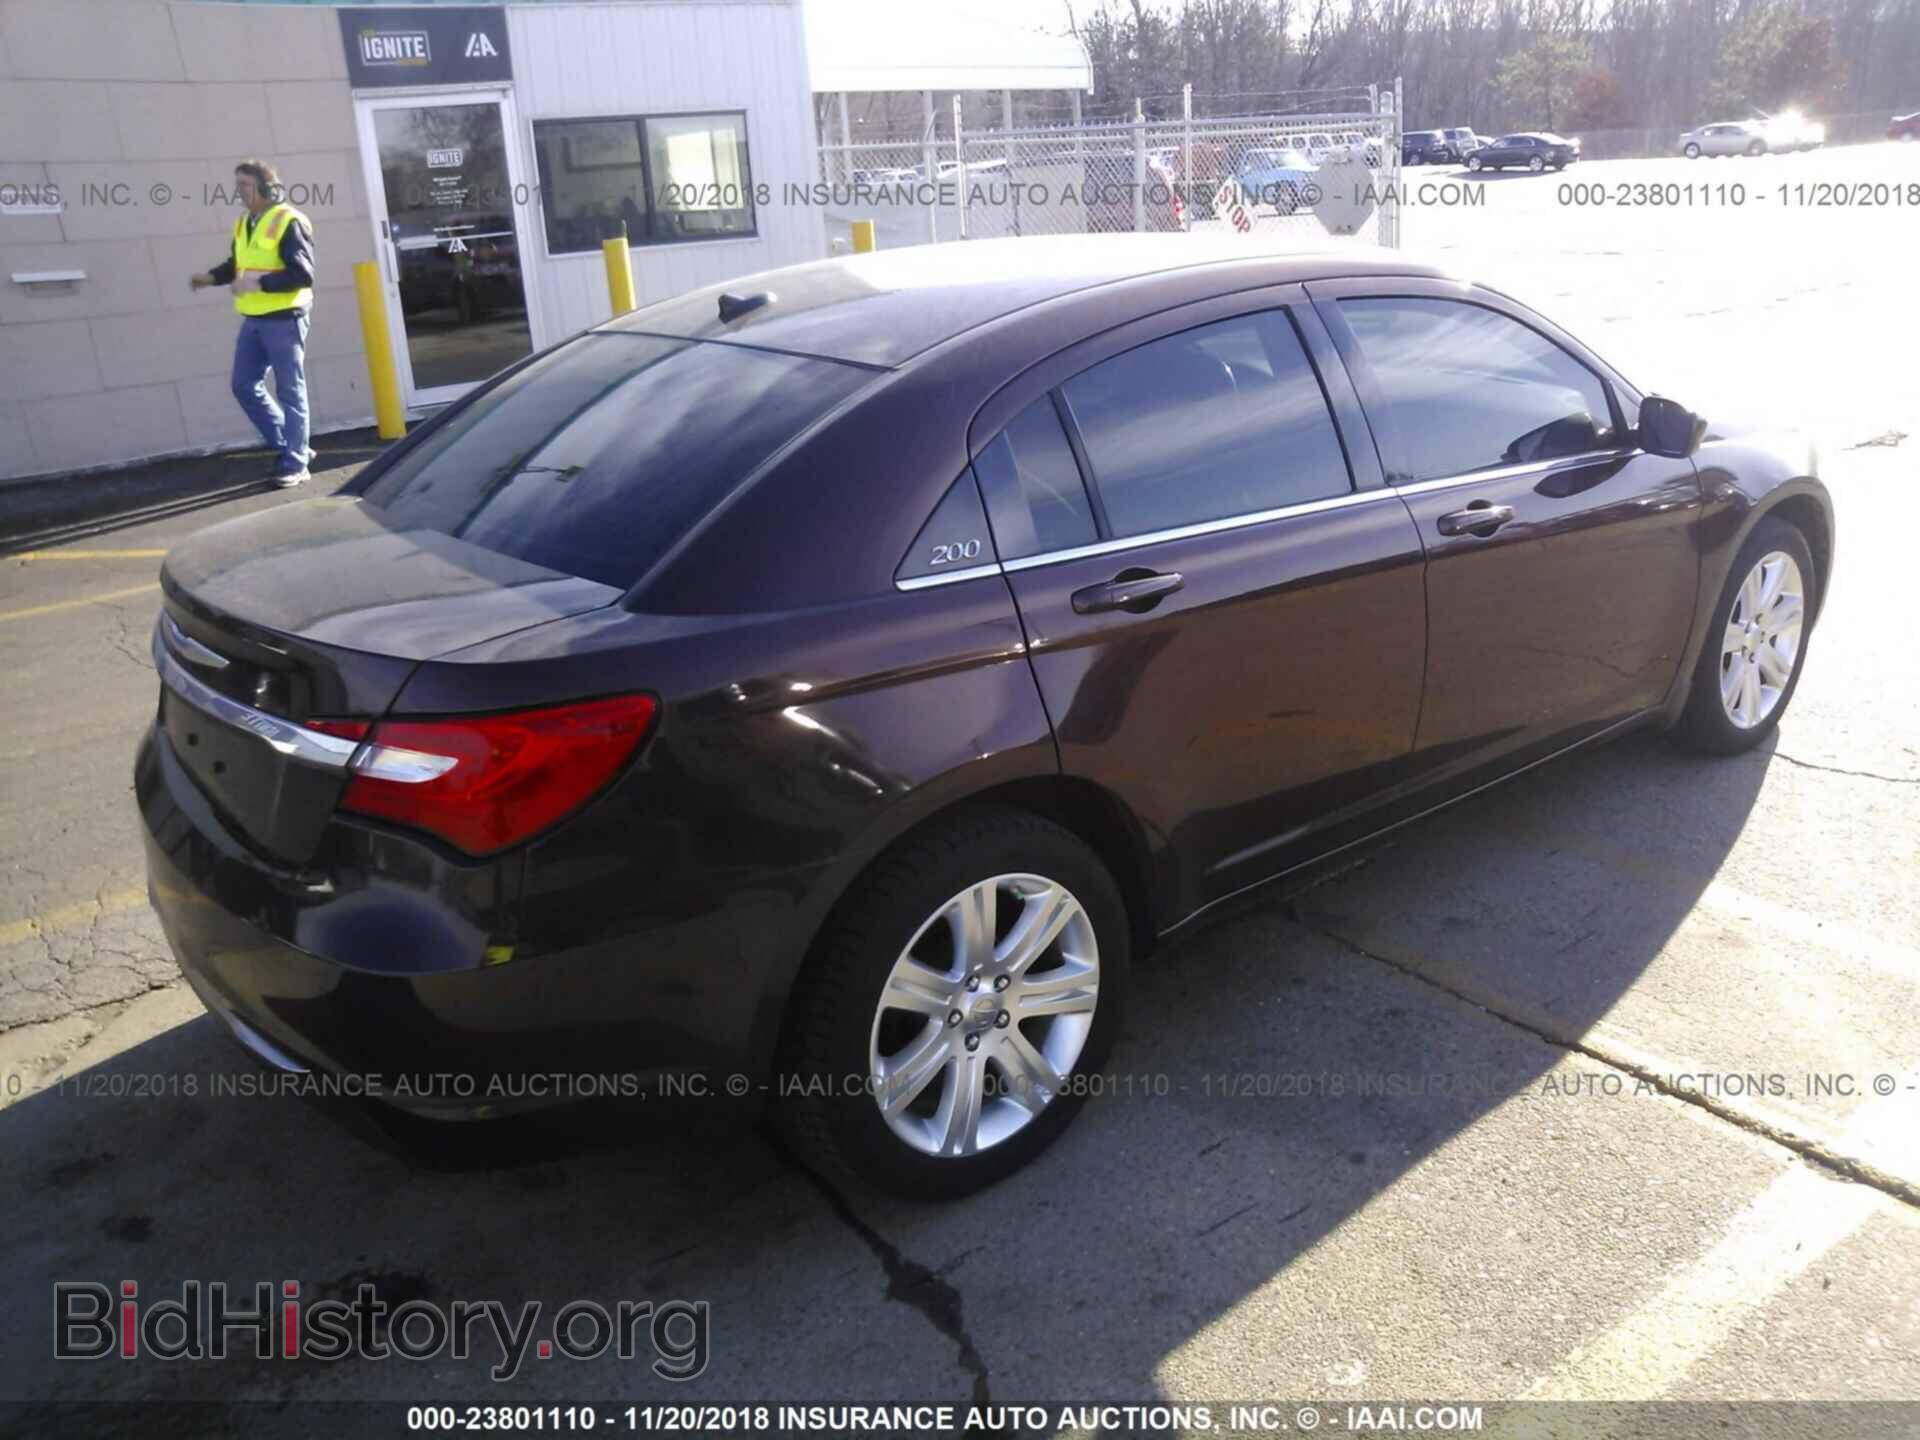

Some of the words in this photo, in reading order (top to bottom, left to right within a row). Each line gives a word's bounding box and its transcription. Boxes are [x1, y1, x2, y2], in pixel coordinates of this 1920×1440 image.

[363, 35, 427, 59] IGNITE
[1219, 185, 1251, 234] STOP
[929, 539, 981, 566] 200
